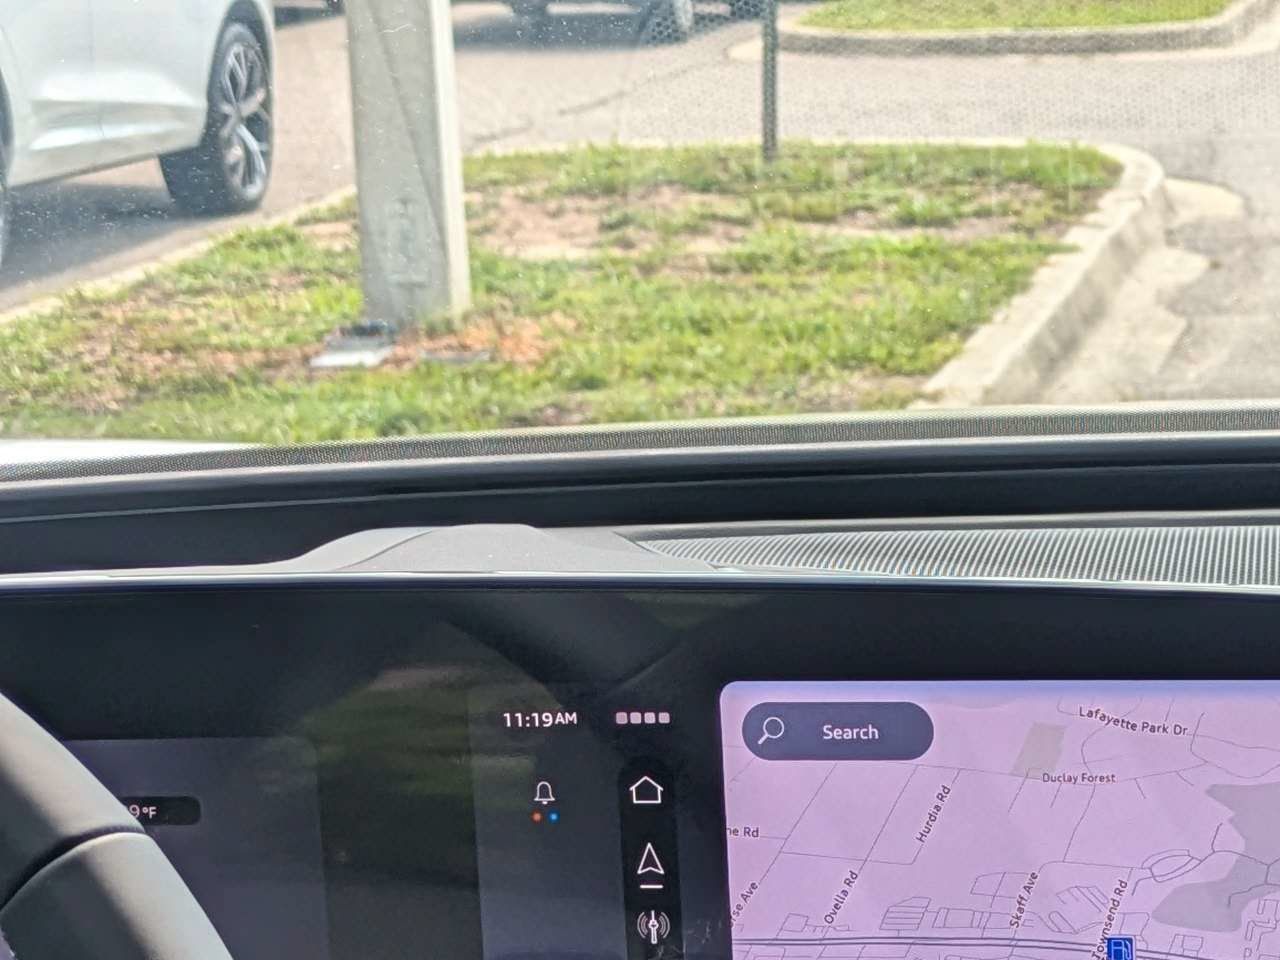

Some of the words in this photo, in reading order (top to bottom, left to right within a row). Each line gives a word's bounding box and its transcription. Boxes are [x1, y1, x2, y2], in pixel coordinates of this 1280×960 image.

[822, 722, 880, 741] Search
[1079, 706, 1138, 732] Lafayette
[1142, 721, 1169, 734] Park
[1173, 724, 1189, 736] Dr
[1042, 772, 1079, 785] Duclay
[1081, 773, 1117, 783] Forest
[915, 804, 942, 843] Hurdia
[936, 784, 951, 803] Rd
[743, 826, 760, 838] Rd
[740, 881, 759, 903] Ave
[823, 888, 850, 925] Ovella
[843, 870, 859, 888] Rd
[1113, 879, 1128, 897] Rd
[1009, 893, 1028, 929] Skaff
[1022, 872, 1039, 895] Ave
